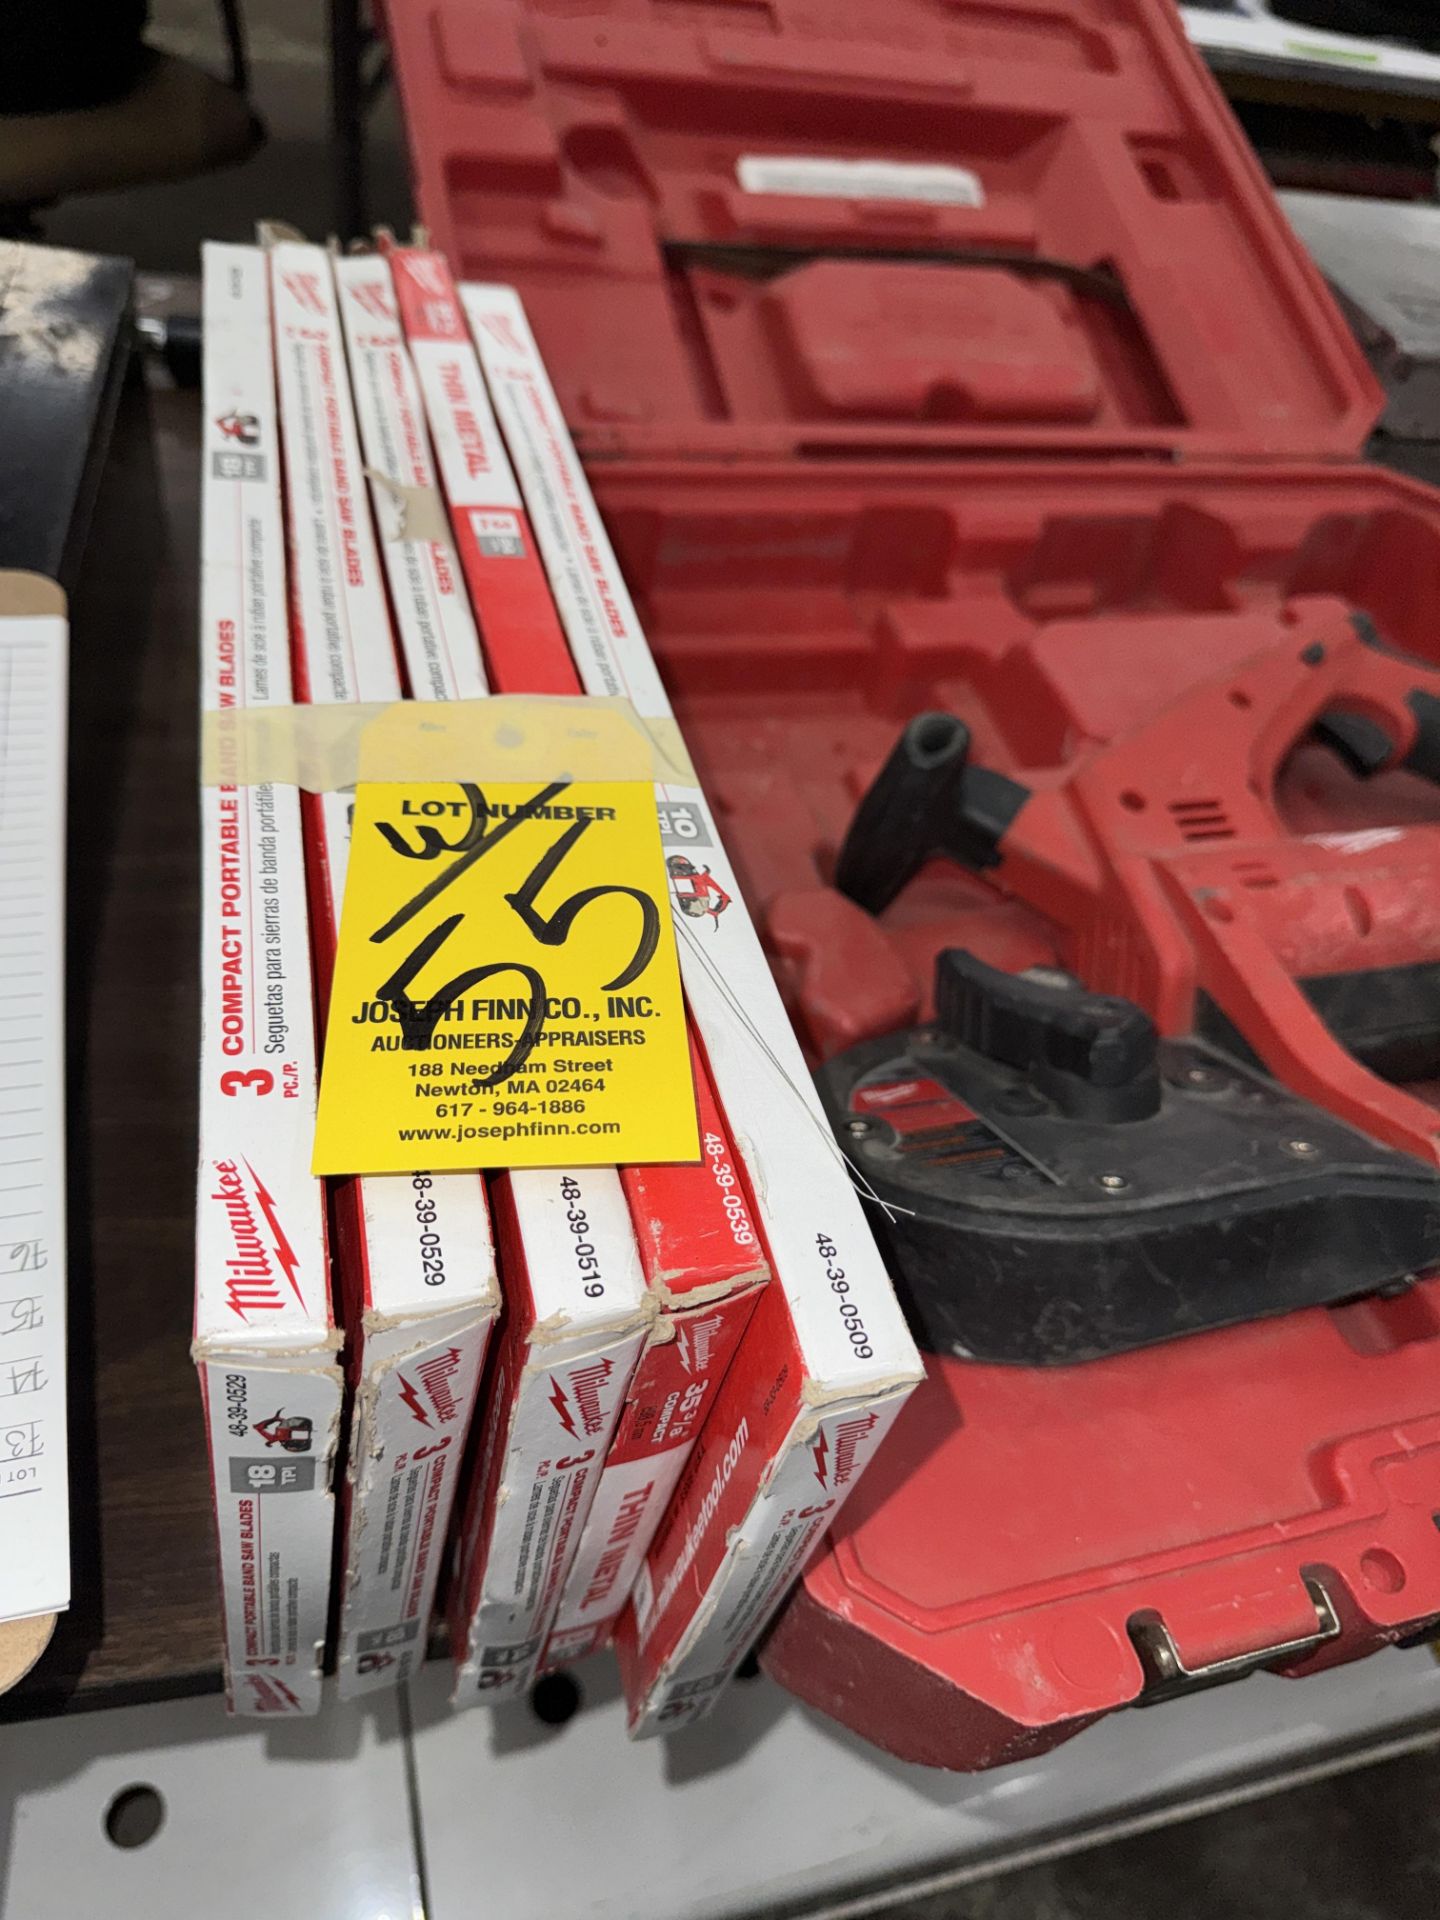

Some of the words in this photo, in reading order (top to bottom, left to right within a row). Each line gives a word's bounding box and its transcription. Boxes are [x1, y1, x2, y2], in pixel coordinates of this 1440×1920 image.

[437, 361, 468, 404] THIN
[453, 407, 492, 481] METAL
[430, 540, 454, 595] LADES
[217, 619, 236, 687] BLADES
[218, 692, 236, 732] SAW
[219, 738, 239, 793] BAND
[402, 799, 467, 818] LOT
[476, 802, 617, 822] NUMBER
[657, 809, 673, 835] TPI
[670, 807, 698, 839] 10
[219, 799, 243, 917] PORTABLE
[259, 835, 279, 874] banda
[261, 877, 279, 895] de
[260, 898, 281, 944] sierras
[266, 948, 287, 980] para
[220, 925, 245, 1056] COMPACT
[351, 999, 464, 1024] JOSEPH
[472, 999, 536, 1021] FINN
[543, 997, 600, 1022] CO.,
[608, 996, 661, 1019] INC.
[264, 984, 289, 1054] Seguetas
[370, 1029, 646, 1052] AUCIONEERS-APPRAISERS
[220, 1069, 275, 1096] 3
[407, 1063, 444, 1077] 188
[450, 1061, 547, 1076] Needham
[553, 1058, 613, 1073] Street
[414, 1081, 500, 1098] Newton,
[507, 1081, 540, 1095] MA
[545, 1078, 606, 1093] 02464
[436, 1104, 473, 1118] 617
[492, 1099, 586, 1115] 964-1886
[398, 1121, 621, 1142] www.josephfinn.com
[703, 1131, 754, 1245] 48-39-0539
[211, 1158, 286, 1324] Milwaukee
[559, 1176, 605, 1298] 48-39-0519
[815, 1232, 873, 1360] 48-39-0509
[225, 1374, 248, 1437] 48-39-0529
[415, 1347, 465, 1425] Milwaukee
[568, 1357, 616, 1436] Milwaukee
[680, 1379, 709, 1412] 35
[651, 1391, 680, 1443] COMPACT
[412, 1435, 452, 1461] 3
[555, 1449, 595, 1471] 3
[833, 1411, 880, 1487] Milwaukee
[7, 1466, 37, 1482] LOT
[247, 1465, 276, 1488] 18
[281, 1466, 297, 1486] TPI
[427, 1454, 447, 1505] COMPACT
[565, 1467, 589, 1516] COMPACT
[239, 1498, 254, 1539] BLADES
[607, 1480, 655, 1545] THIN
[241, 1541, 255, 1561] SAW
[242, 1562, 256, 1585] BAND
[579, 1543, 630, 1610] METAL
[243, 1586, 257, 1625] PORTABLE
